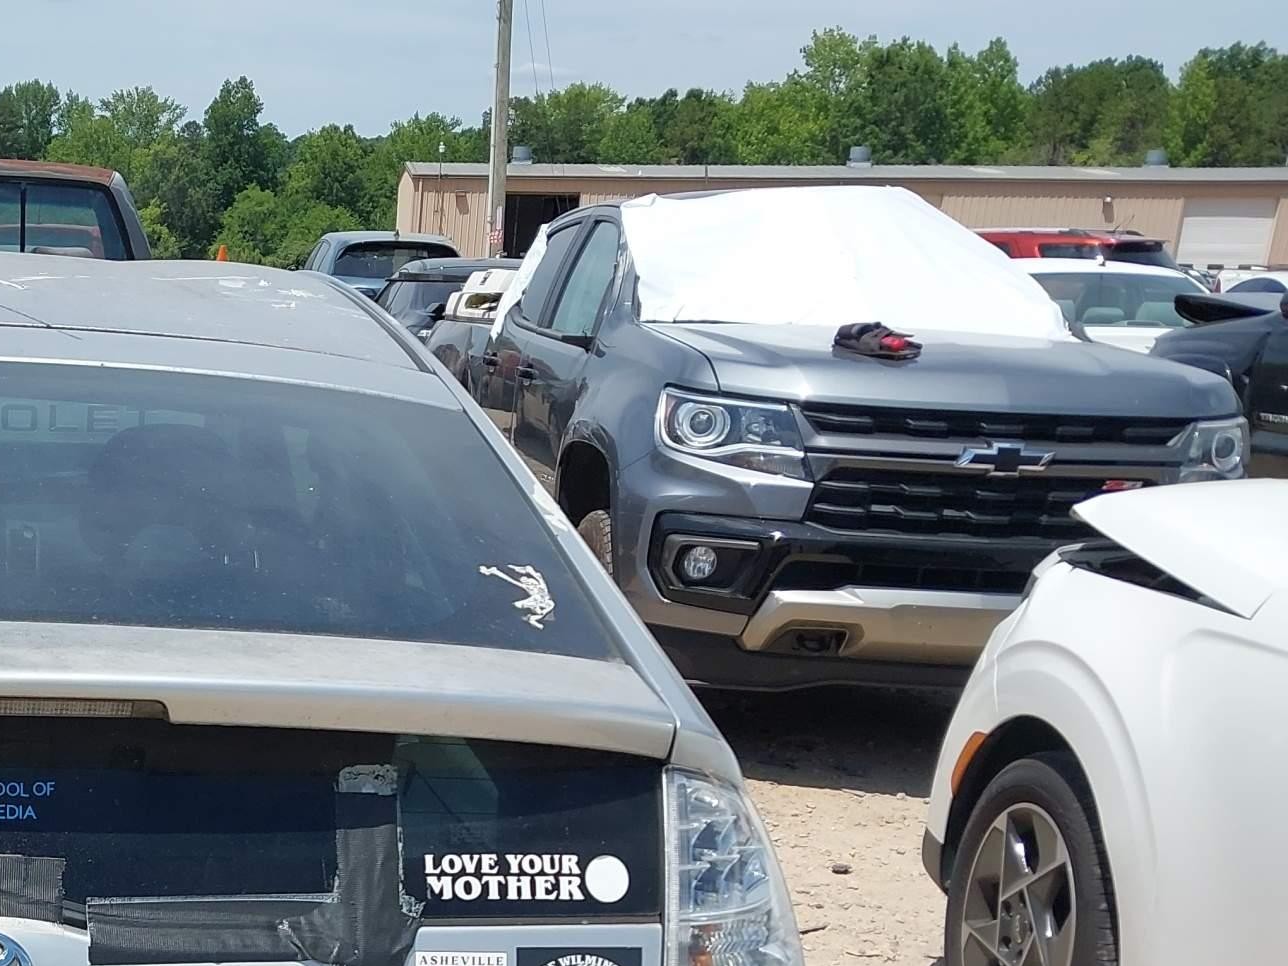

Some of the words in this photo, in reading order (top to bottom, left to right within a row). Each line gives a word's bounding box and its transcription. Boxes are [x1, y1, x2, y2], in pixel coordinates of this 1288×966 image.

[32, 781, 55, 797] OF
[424, 853, 499, 874] LOVE
[505, 854, 582, 874] YOUR
[426, 875, 585, 901] MOTHER
[419, 955, 505, 966] ASHEVILLE
